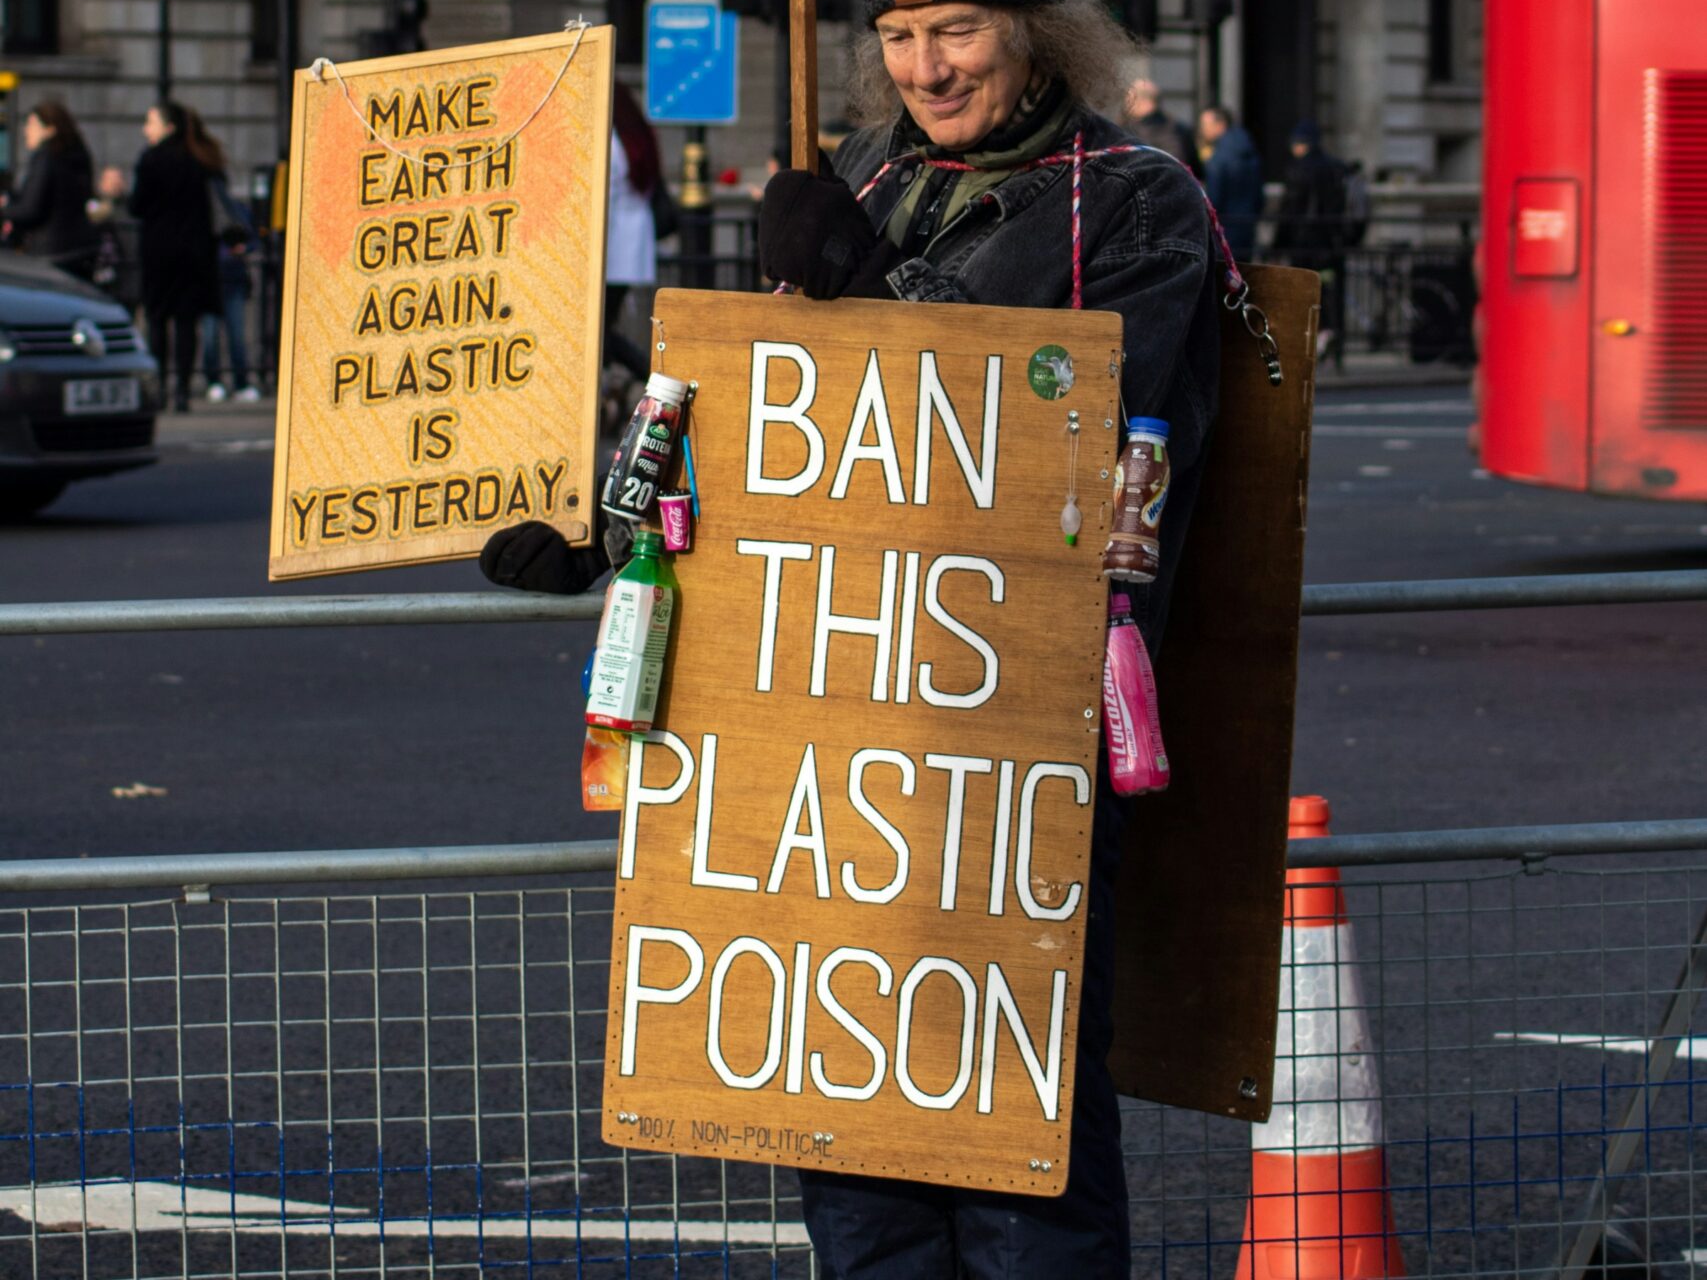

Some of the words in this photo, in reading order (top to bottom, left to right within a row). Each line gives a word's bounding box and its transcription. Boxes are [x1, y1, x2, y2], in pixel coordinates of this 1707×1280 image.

[367, 80, 495, 141] MAKE
[360, 141, 514, 207] EARTH
[359, 206, 518, 271] GREAT
[357, 275, 513, 336] AGAIN.
[333, 336, 533, 404] PLASTIC
[411, 413, 454, 463] IS
[745, 340, 1003, 510] BAN
[291, 463, 580, 543] YESTERDAY.
[736, 539, 1005, 710] THIS
[619, 729, 1091, 921] PLASTIC
[619, 924, 1068, 1121] POISON
[638, 1116, 676, 1139] 100%
